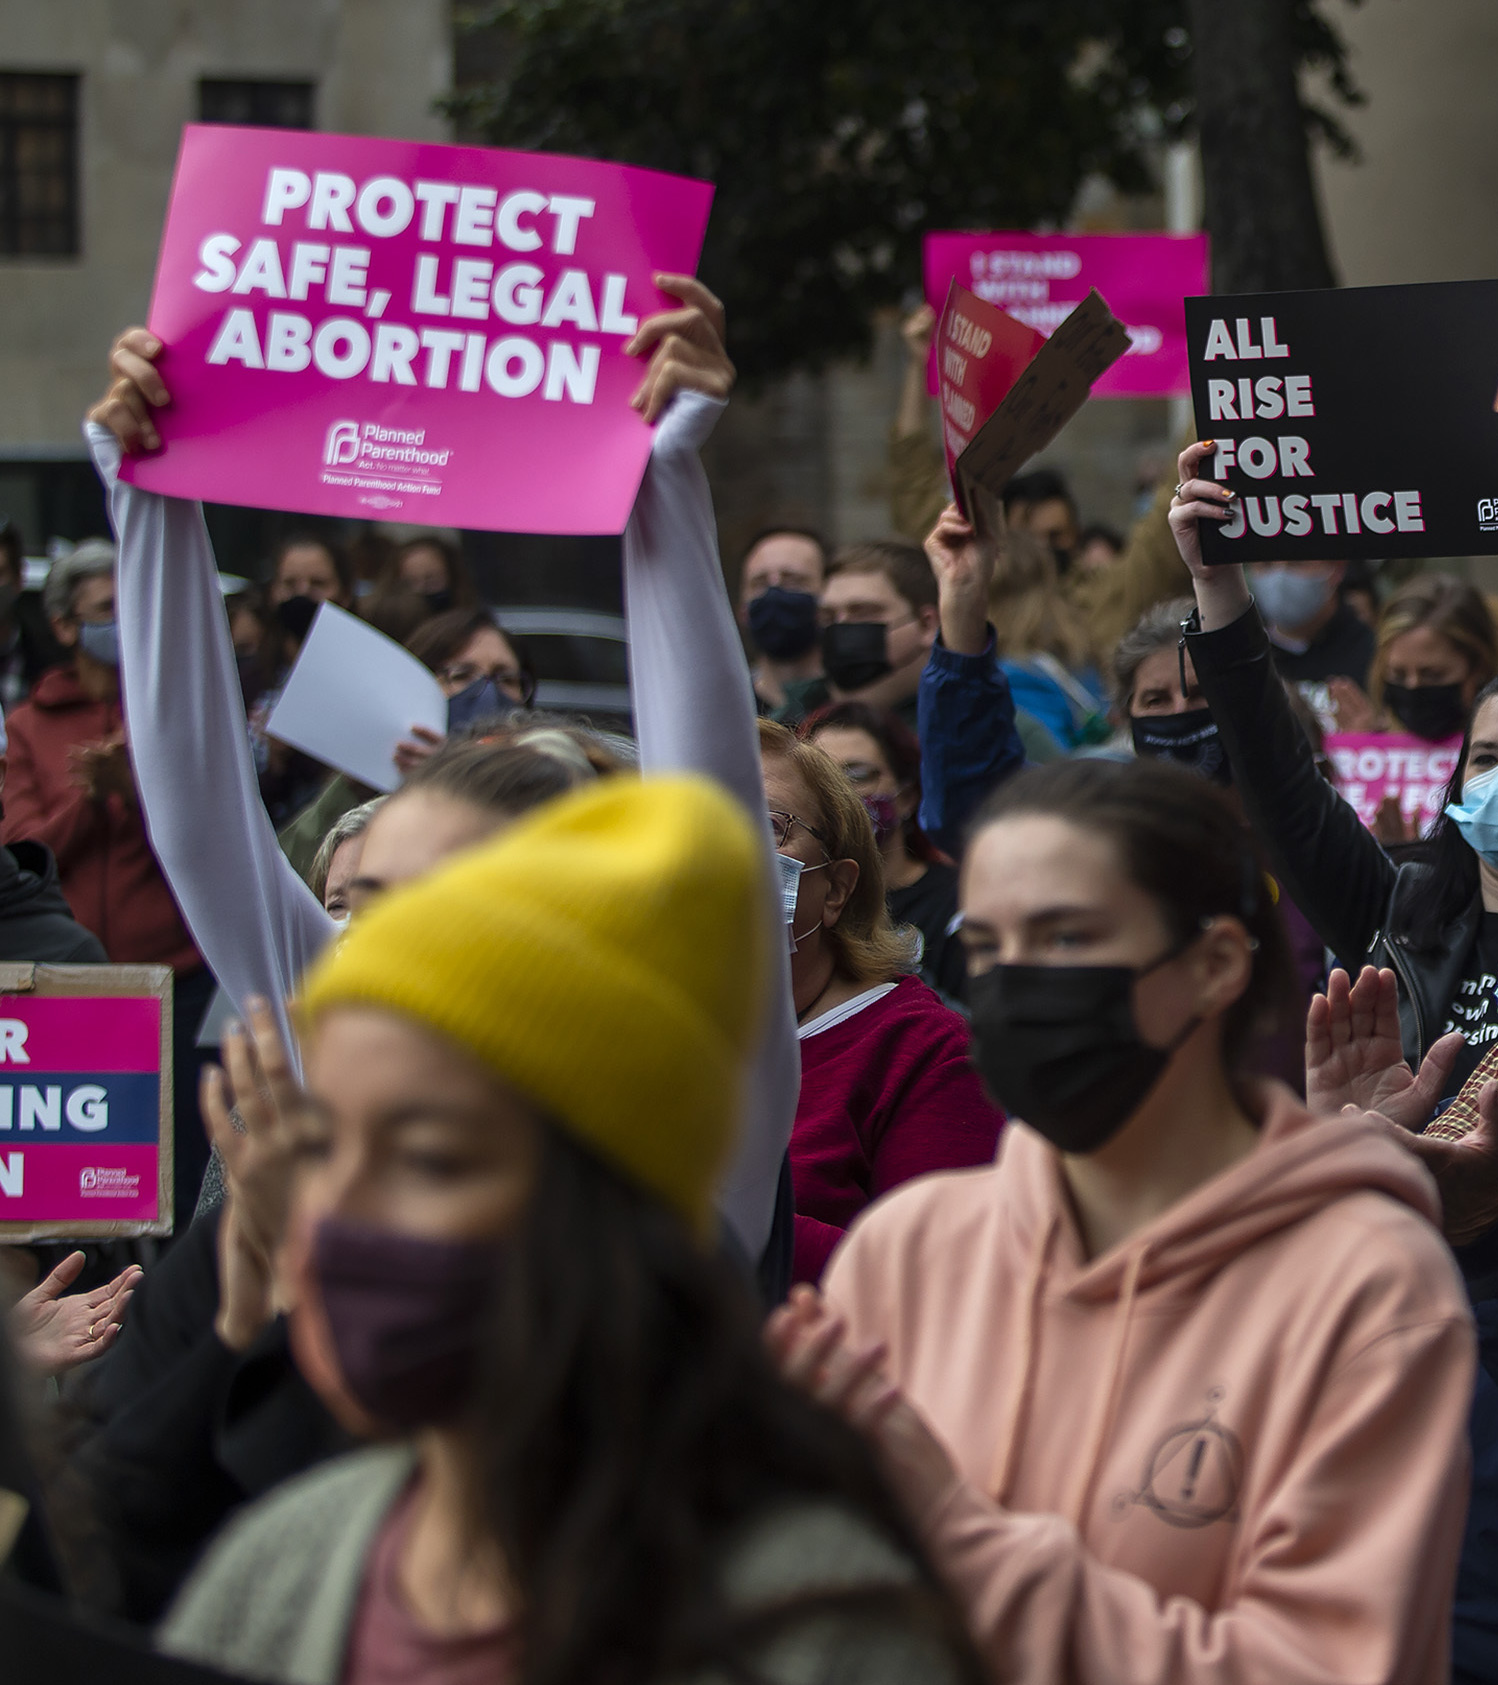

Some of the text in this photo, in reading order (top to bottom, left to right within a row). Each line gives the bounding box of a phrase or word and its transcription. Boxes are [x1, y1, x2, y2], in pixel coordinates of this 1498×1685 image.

[262, 167, 596, 255] PROTECT
[194, 234, 639, 336] SAFE, LEGAL
[207, 308, 601, 406] ABORTION
[951, 312, 992, 359] STAND
[1204, 316, 1290, 361] ALL
[1208, 375, 1316, 421] RISE
[361, 442, 450, 467] Parenthood
[364, 424, 425, 446] Planned
[1214, 436, 1316, 480] FOR
[322, 473, 442, 496] Planned Parenthood Action Fund
[1218, 490, 1426, 540] JUSTICE
